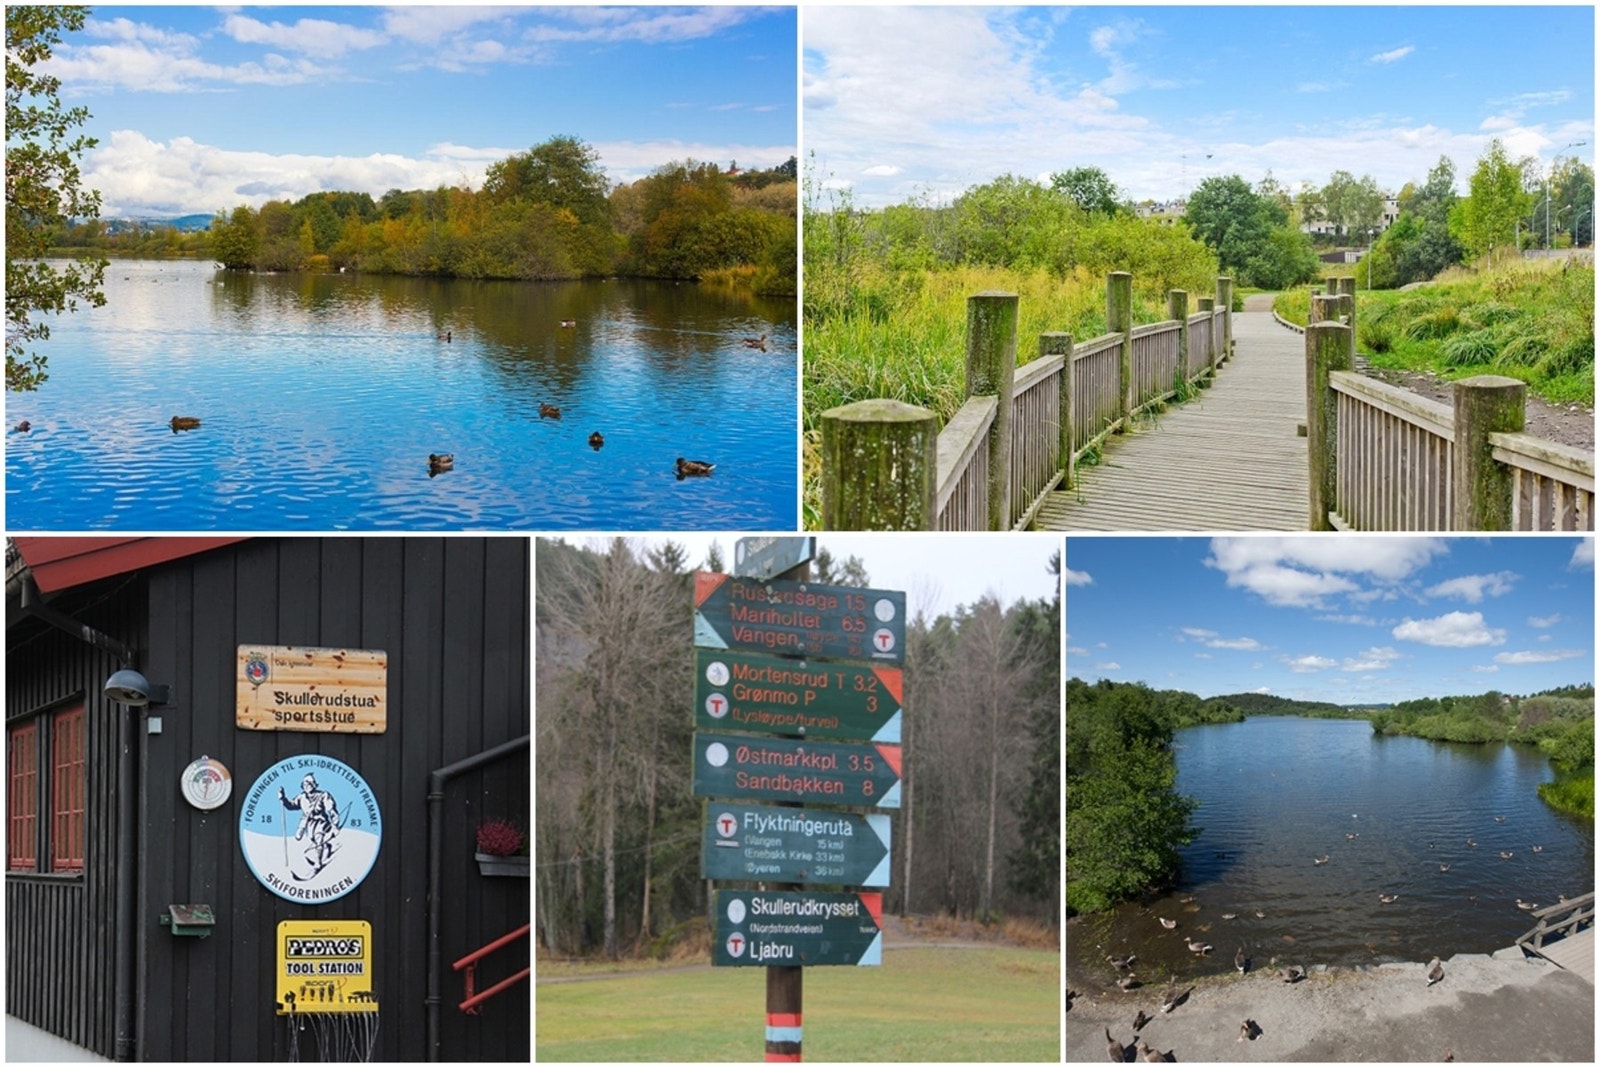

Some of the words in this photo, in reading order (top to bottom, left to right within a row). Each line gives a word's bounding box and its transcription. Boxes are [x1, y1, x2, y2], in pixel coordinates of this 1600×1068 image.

[842, 615, 866, 632] 6.5
[732, 625, 798, 648] Vangen
[733, 663, 828, 688] Mortensrud
[835, 673, 846, 689] T
[854, 675, 877, 692] 3.2
[275, 691, 376, 707] Skullerudstua
[733, 683, 798, 705] Grønmo
[805, 691, 816, 706] P
[867, 696, 877, 712] 3
[275, 710, 355, 724] sportsstue
[849, 755, 874, 771] 3.5
[245, 771, 280, 823] FORENINGEN
[281, 763, 295, 774] TIL
[298, 759, 361, 789] SKI-IDRETTENS
[359, 788, 378, 827] FREMME
[736, 772, 843, 794] Sandbakken
[862, 780, 874, 796] 8
[261, 815, 272, 824] 18
[350, 818, 361, 827] 83
[744, 812, 853, 836] Flyktningeruta
[789, 850, 813, 861] Kirke
[265, 872, 354, 899] SKIFORENINGEN
[751, 897, 859, 920] Skullerudkrysset
[288, 938, 360, 956] PEDRO'S
[750, 941, 793, 961] Ljabru
[287, 963, 315, 974] TOOL
[318, 963, 363, 974] STATION
